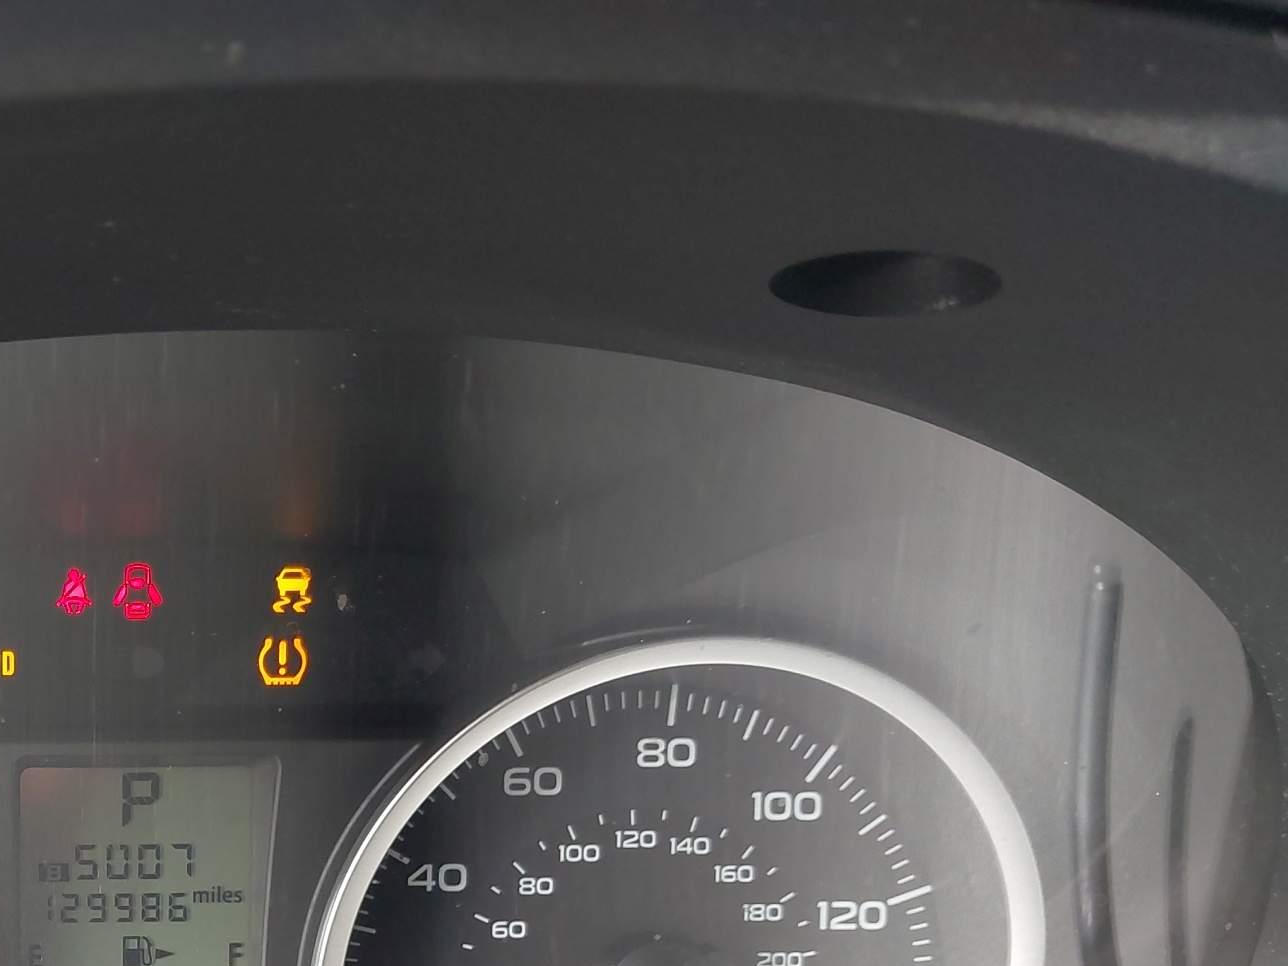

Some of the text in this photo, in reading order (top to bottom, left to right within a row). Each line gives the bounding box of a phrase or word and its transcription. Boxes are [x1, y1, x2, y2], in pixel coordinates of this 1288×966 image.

[637, 738, 696, 767] 80
[504, 767, 562, 795] 60
[122, 772, 160, 826] P
[752, 792, 821, 820] 100
[559, 845, 600, 861] 100
[616, 831, 656, 848] 120
[670, 838, 710, 854] 140
[75, 844, 193, 880] 5007
[406, 860, 467, 891] 40
[715, 865, 753, 882] 160
[519, 878, 553, 894] 80
[48, 886, 242, 923] 129986 miles
[743, 904, 782, 921] 180
[818, 899, 886, 929] 120
[492, 921, 525, 938] 60
